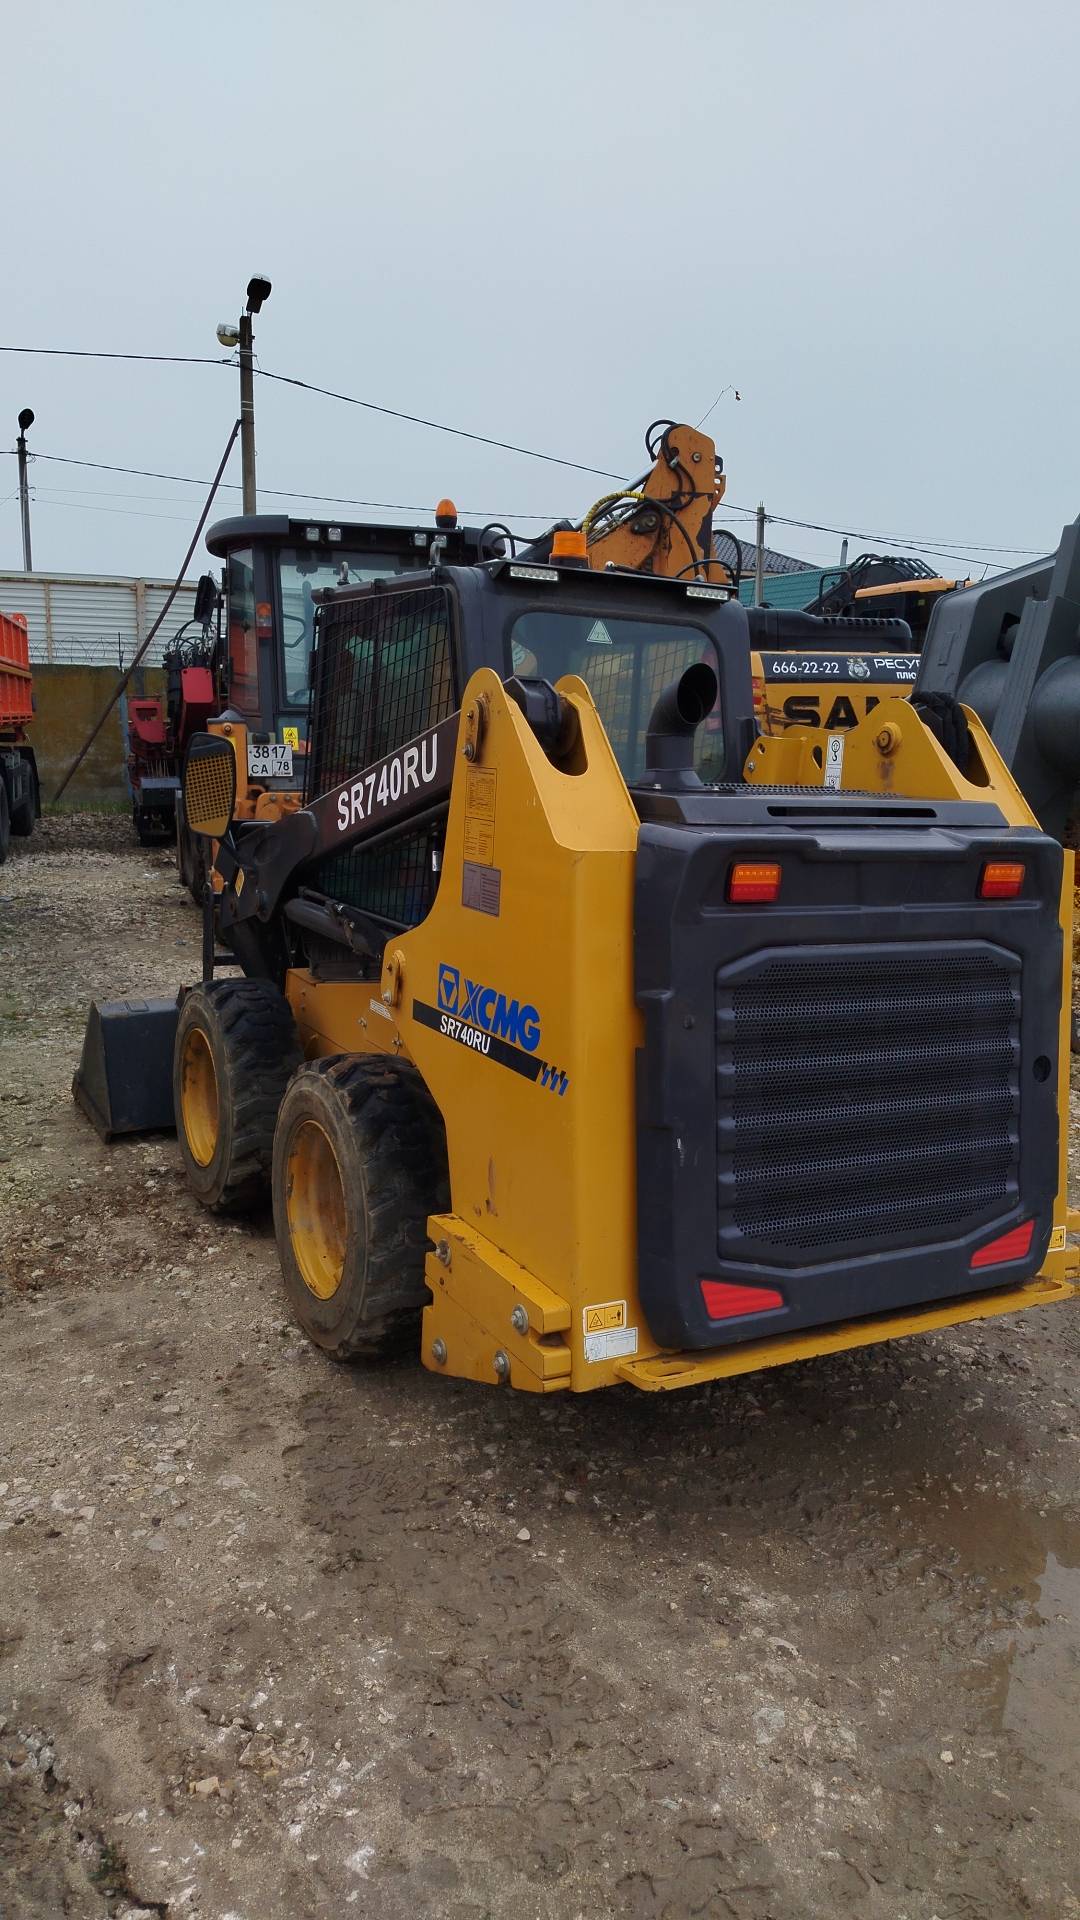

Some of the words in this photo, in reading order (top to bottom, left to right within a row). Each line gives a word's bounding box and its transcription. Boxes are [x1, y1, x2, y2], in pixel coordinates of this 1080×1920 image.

[772, 661, 840, 674] 666-22-22
[783, 696, 880, 732] SA
[253, 745, 286, 759] 3817
[276, 761, 290, 771] 78
[337, 733, 438, 831] SR740RU
[459, 978, 541, 1052] XCMG
[440, 1015, 492, 1054] SR740RU
